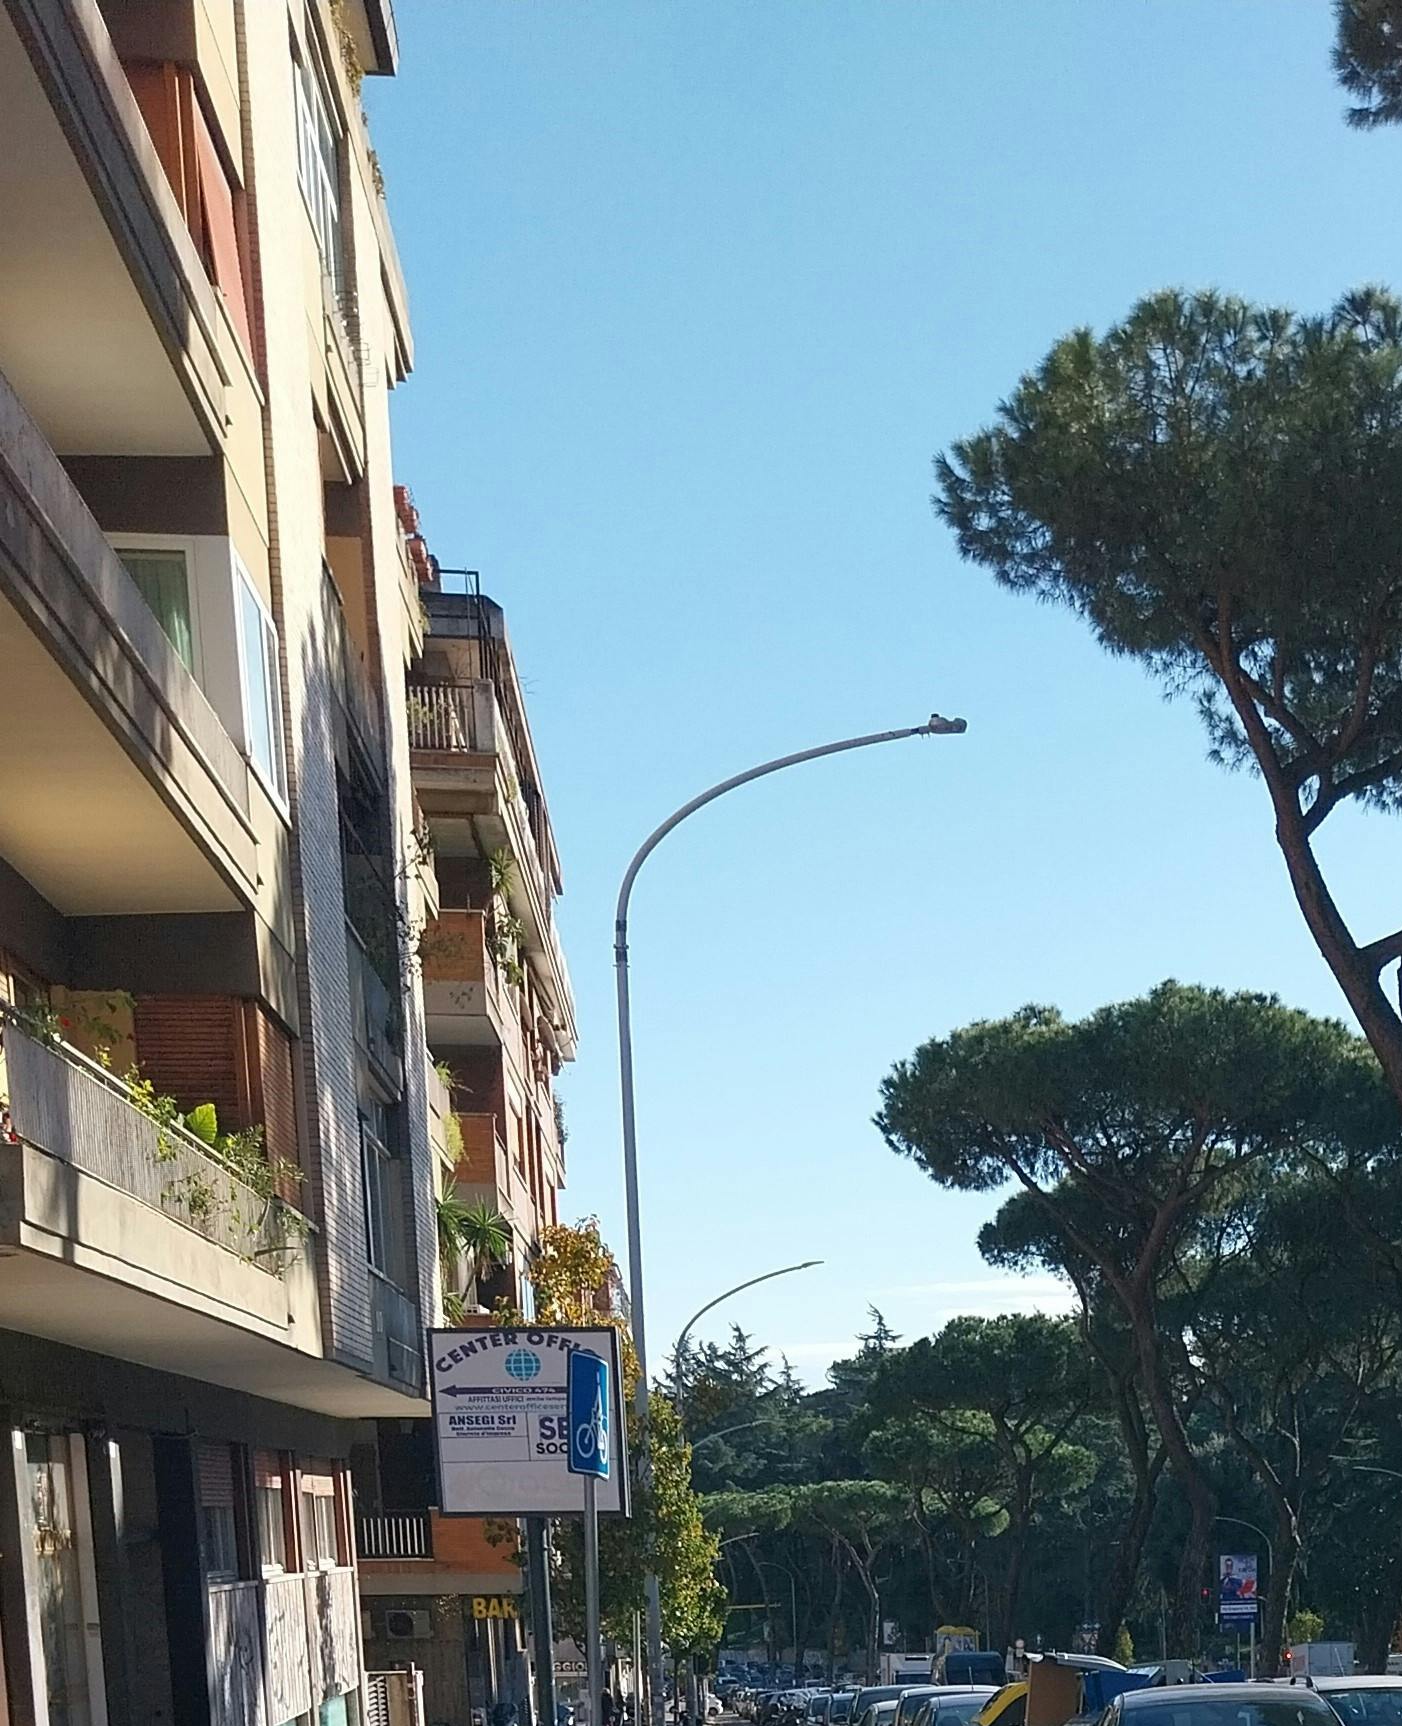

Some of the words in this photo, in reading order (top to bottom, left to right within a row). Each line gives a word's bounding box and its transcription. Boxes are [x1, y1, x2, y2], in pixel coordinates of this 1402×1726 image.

[436, 1332, 519, 1372] CENTER
[526, 1332, 595, 1354] OFFI
[449, 1415, 495, 1425] ANSEGI
[498, 1414, 516, 1425] Srl
[472, 1598, 518, 1619] BAR
